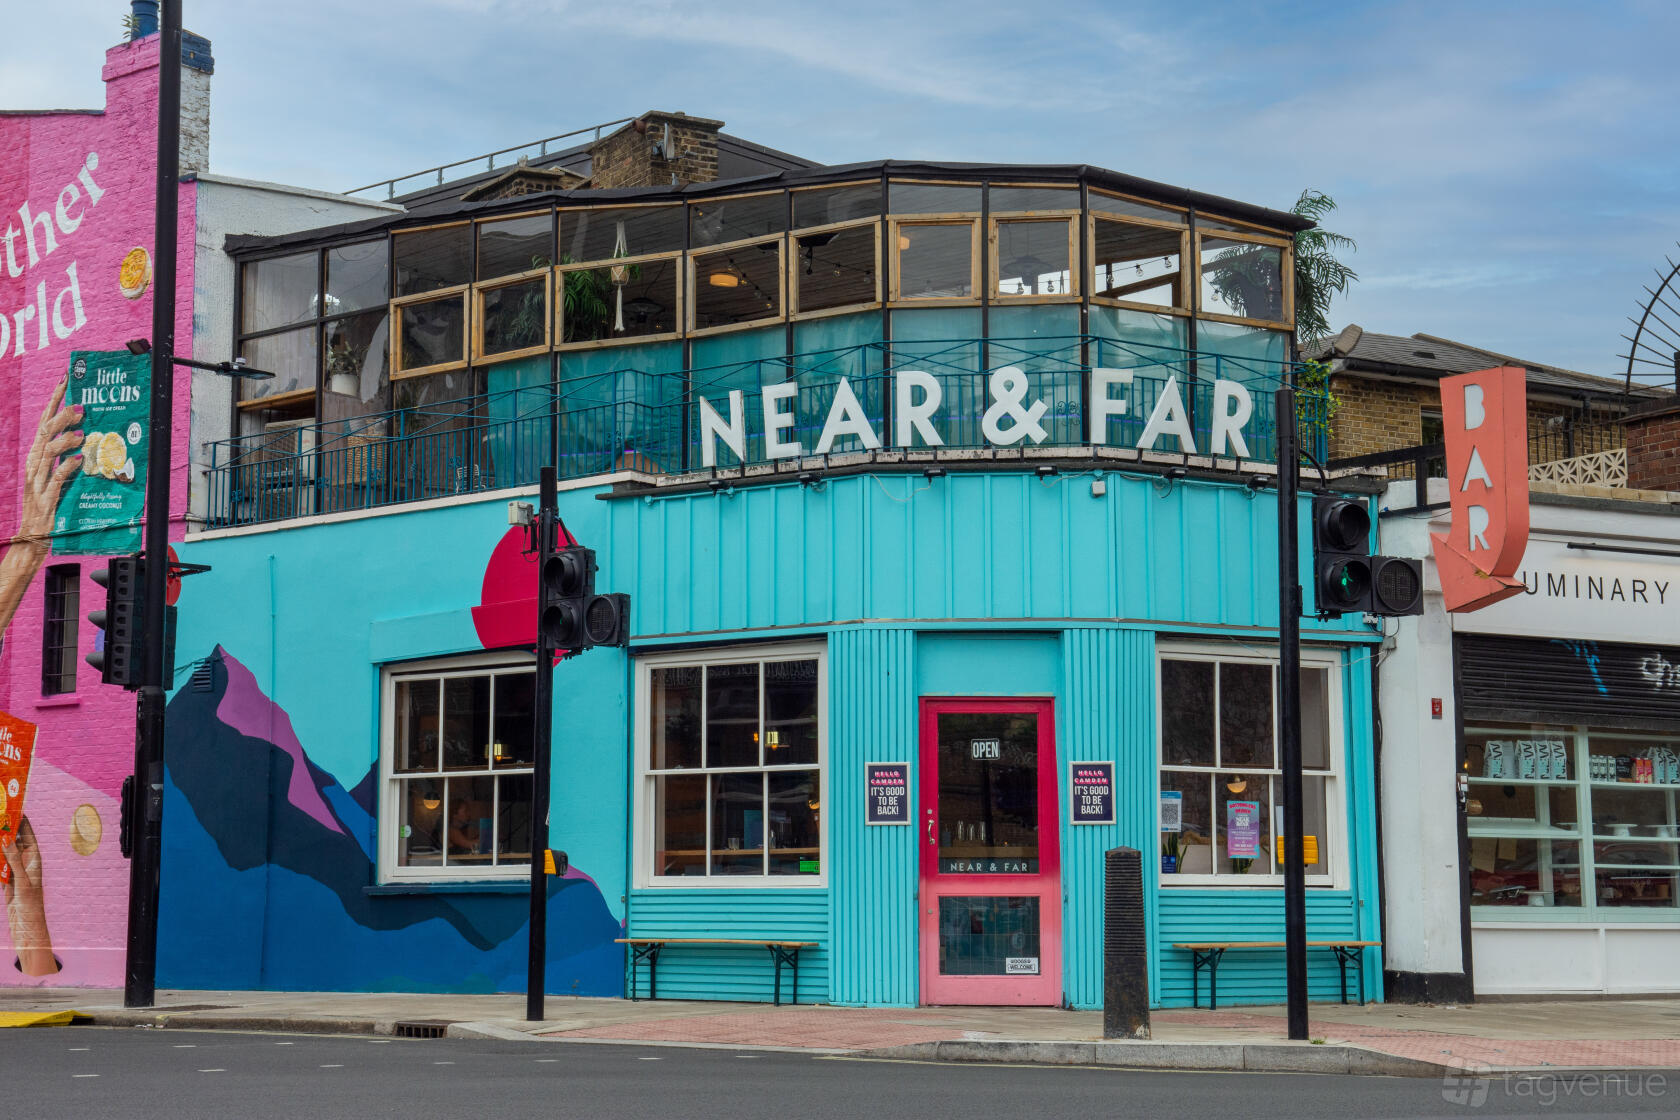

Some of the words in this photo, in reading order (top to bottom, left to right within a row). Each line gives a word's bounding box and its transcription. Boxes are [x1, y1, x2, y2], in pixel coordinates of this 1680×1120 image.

[0, 152, 106, 278] ther
[97, 368, 127, 385] little
[82, 385, 140, 405] moons
[700, 371, 946, 467] NEAR
[982, 366, 1048, 445] &
[1091, 367, 1252, 457] FAR
[1460, 384, 1493, 552] BAR
[1523, 571, 1670, 604] UMINARY
[973, 742, 998, 758] OPEN
[871, 787, 884, 796] IT'S
[886, 787, 904, 796] GOOD
[1074, 786, 1088, 795] IT'S
[1090, 786, 1109, 795] GOOD
[878, 797, 887, 805] TO
[889, 797, 898, 805] BE
[1082, 796, 1090, 804] TO
[1093, 796, 1102, 804] BE
[878, 806, 899, 815] BACK!
[1081, 805, 1103, 814] BACK!
[950, 863, 982, 872] NEAR
[989, 863, 997, 872] &
[1004, 863, 1028, 872] FAR
